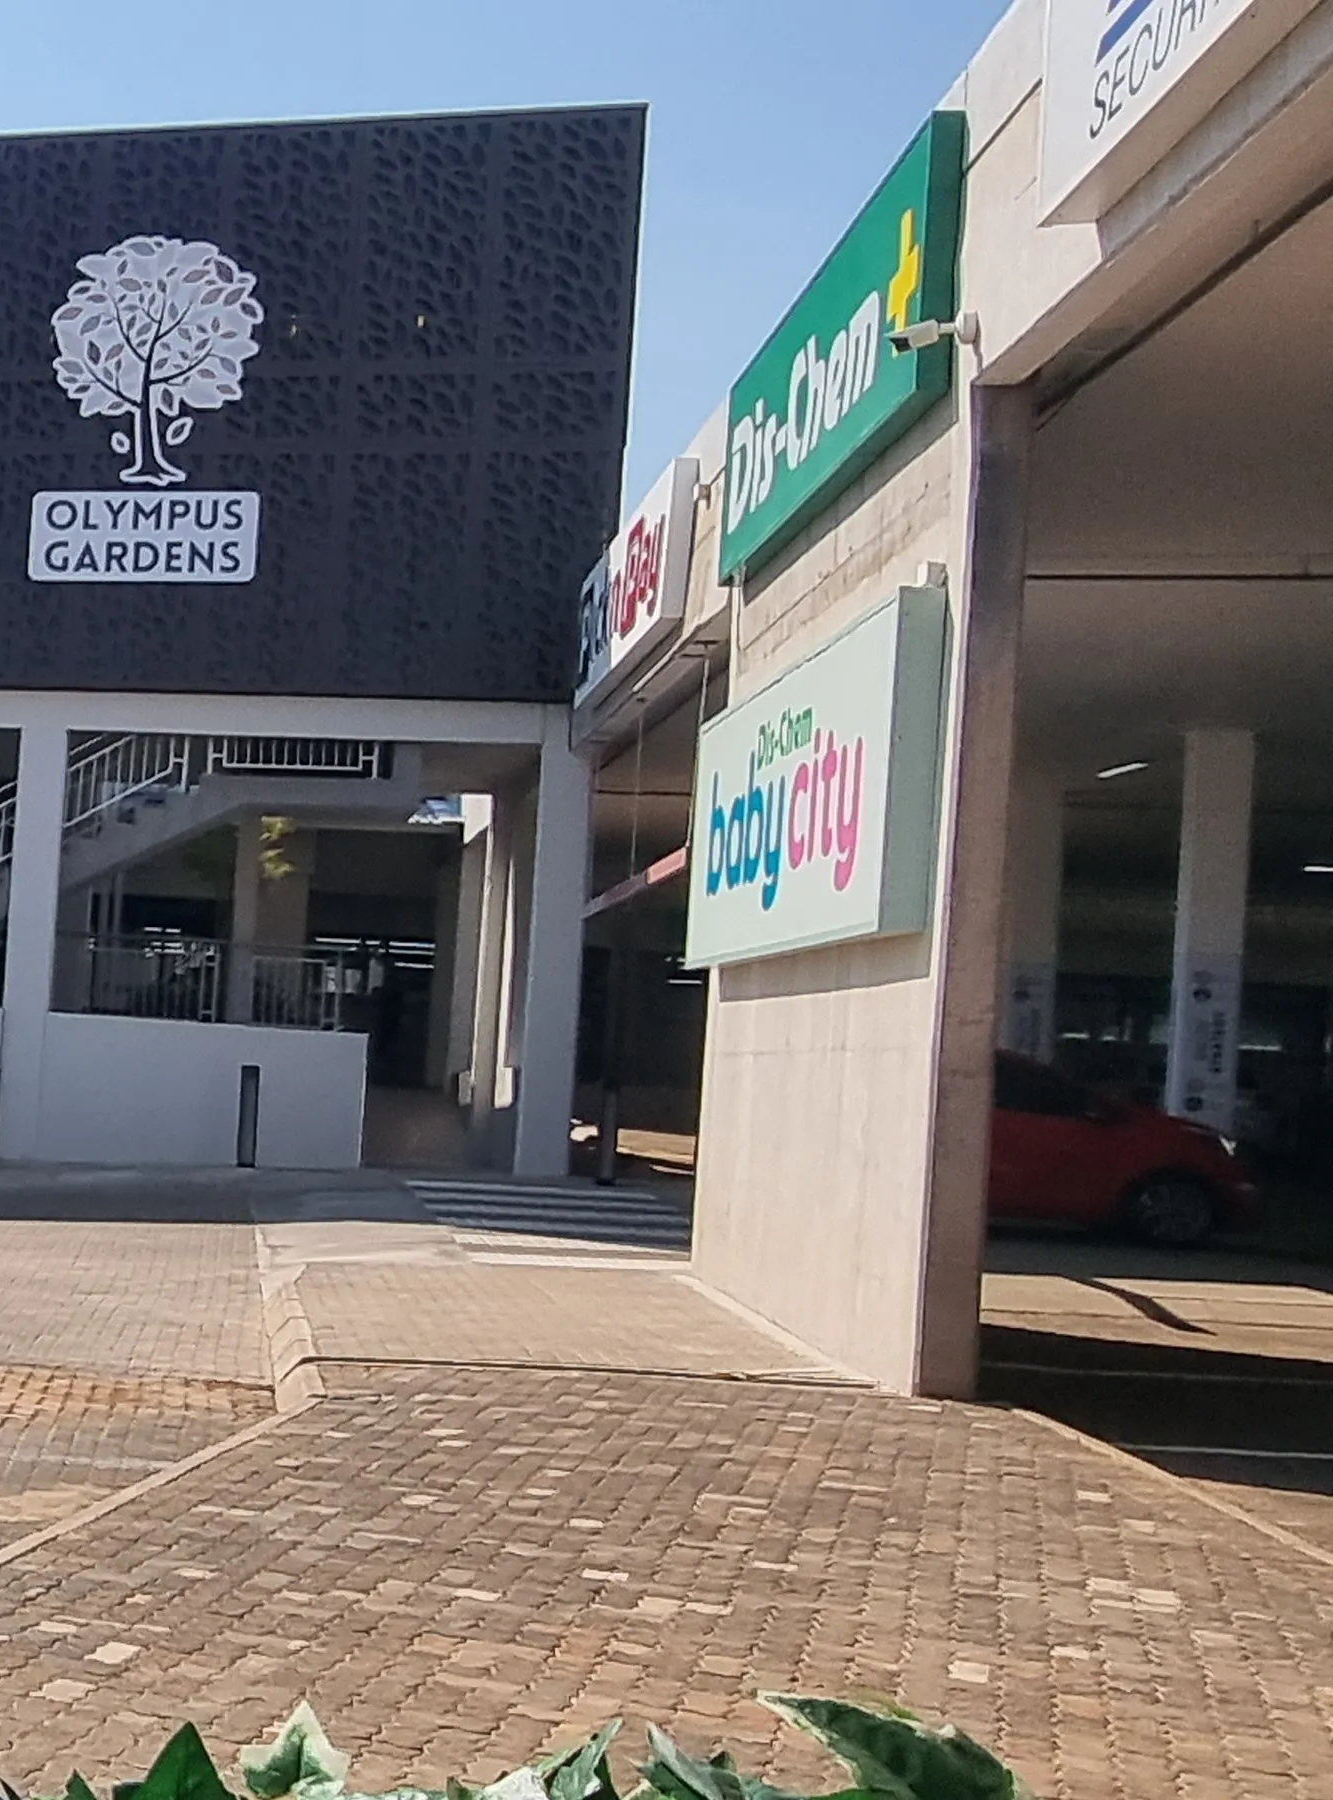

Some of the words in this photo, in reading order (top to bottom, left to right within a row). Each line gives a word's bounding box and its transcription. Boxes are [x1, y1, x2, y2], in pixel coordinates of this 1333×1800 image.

[727, 290, 880, 535] Dis-Chem
[45, 499, 244, 531] OLYMPUS
[44, 541, 241, 574] GARDENS
[756, 707, 813, 770] Dis-Chem
[706, 749, 786, 911] baby
[788, 727, 864, 892] city
